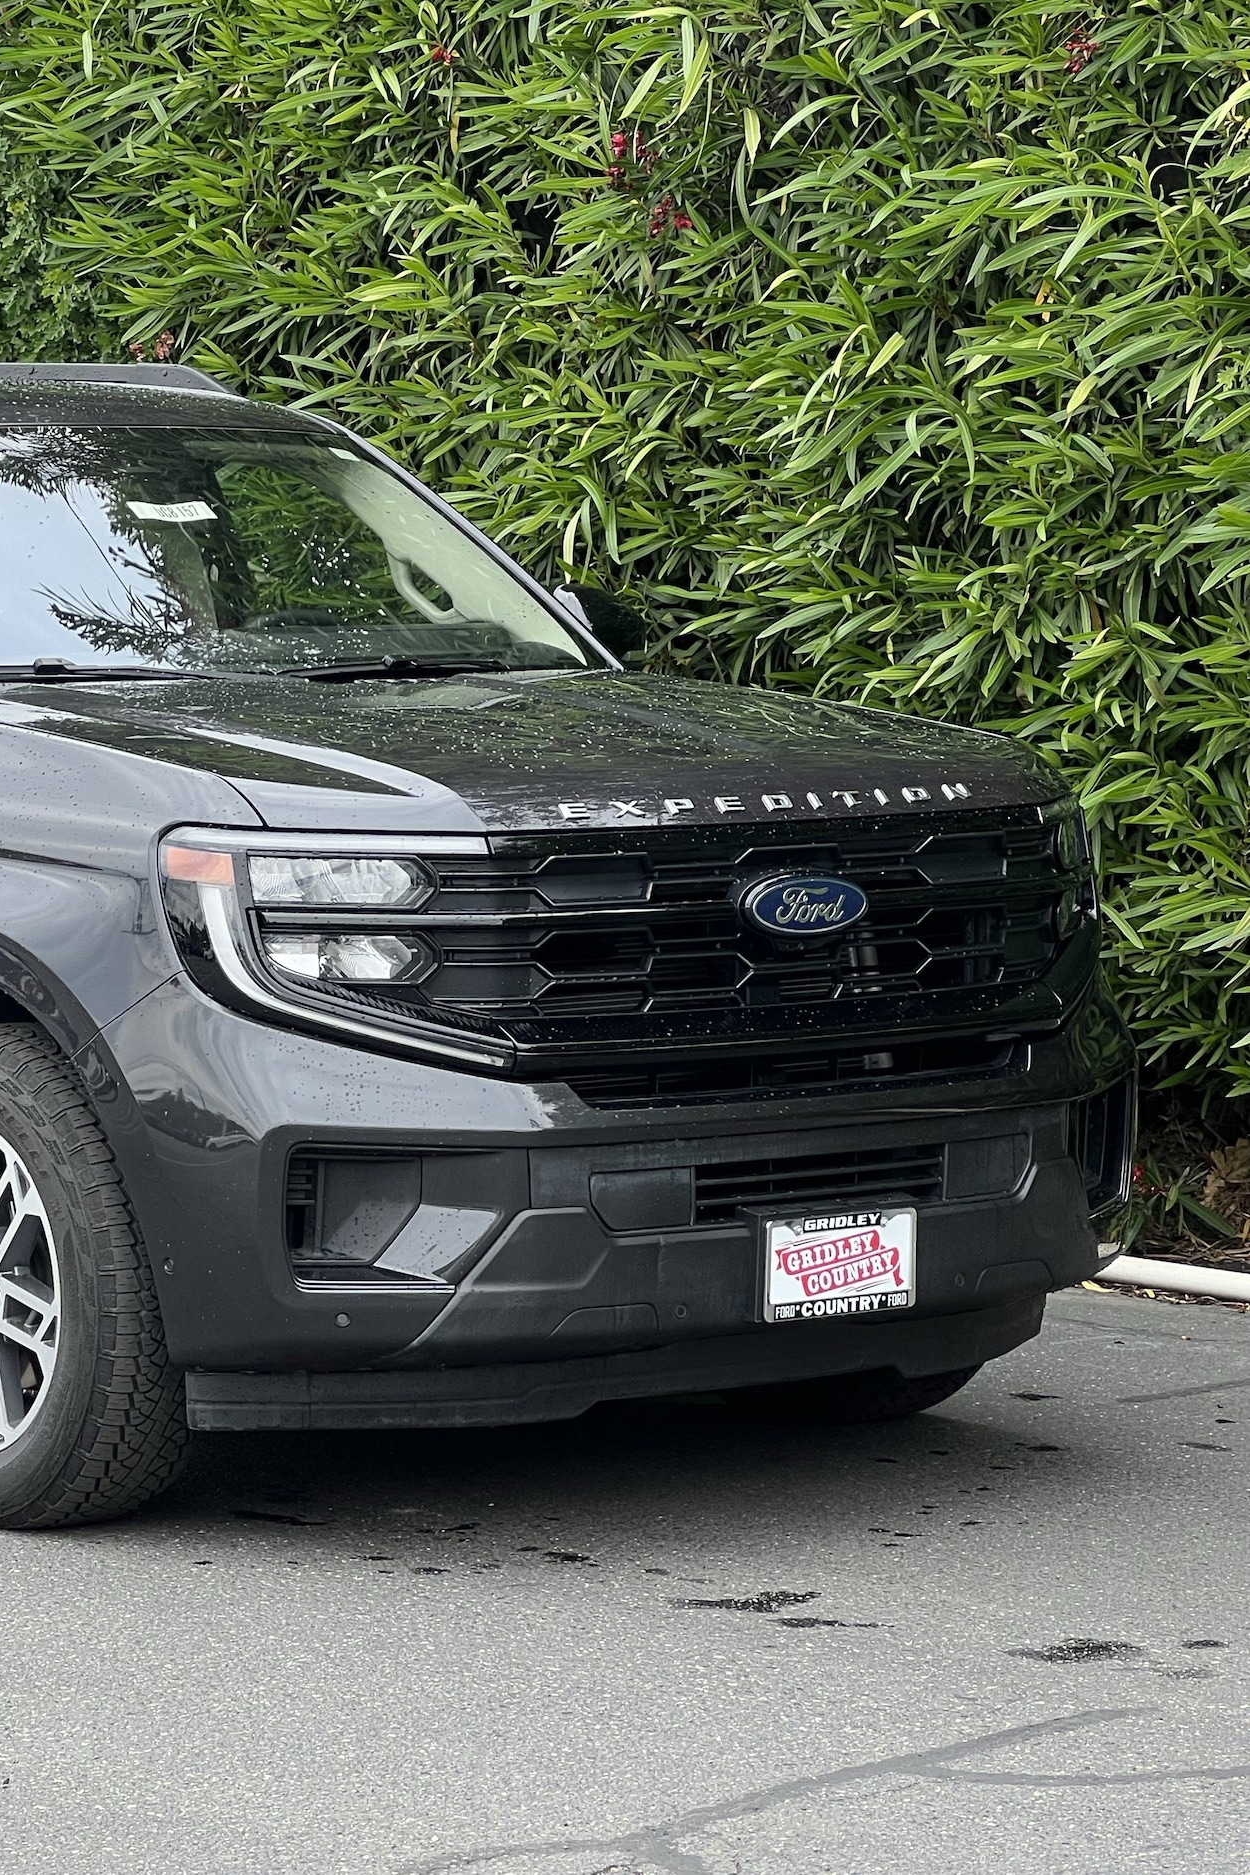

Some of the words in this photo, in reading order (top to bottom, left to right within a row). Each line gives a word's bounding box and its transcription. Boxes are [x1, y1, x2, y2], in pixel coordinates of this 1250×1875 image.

[557, 782, 973, 821] EXPEDITION
[775, 886, 846, 924] Ford
[804, 1213, 881, 1231] GRIDLEY
[786, 1232, 875, 1272] GRIDLEY
[807, 1251, 895, 1294] COUNTRY
[775, 1304, 796, 1319] FORD
[801, 1294, 882, 1317] COUNTRY
[887, 1292, 907, 1307] FORD
